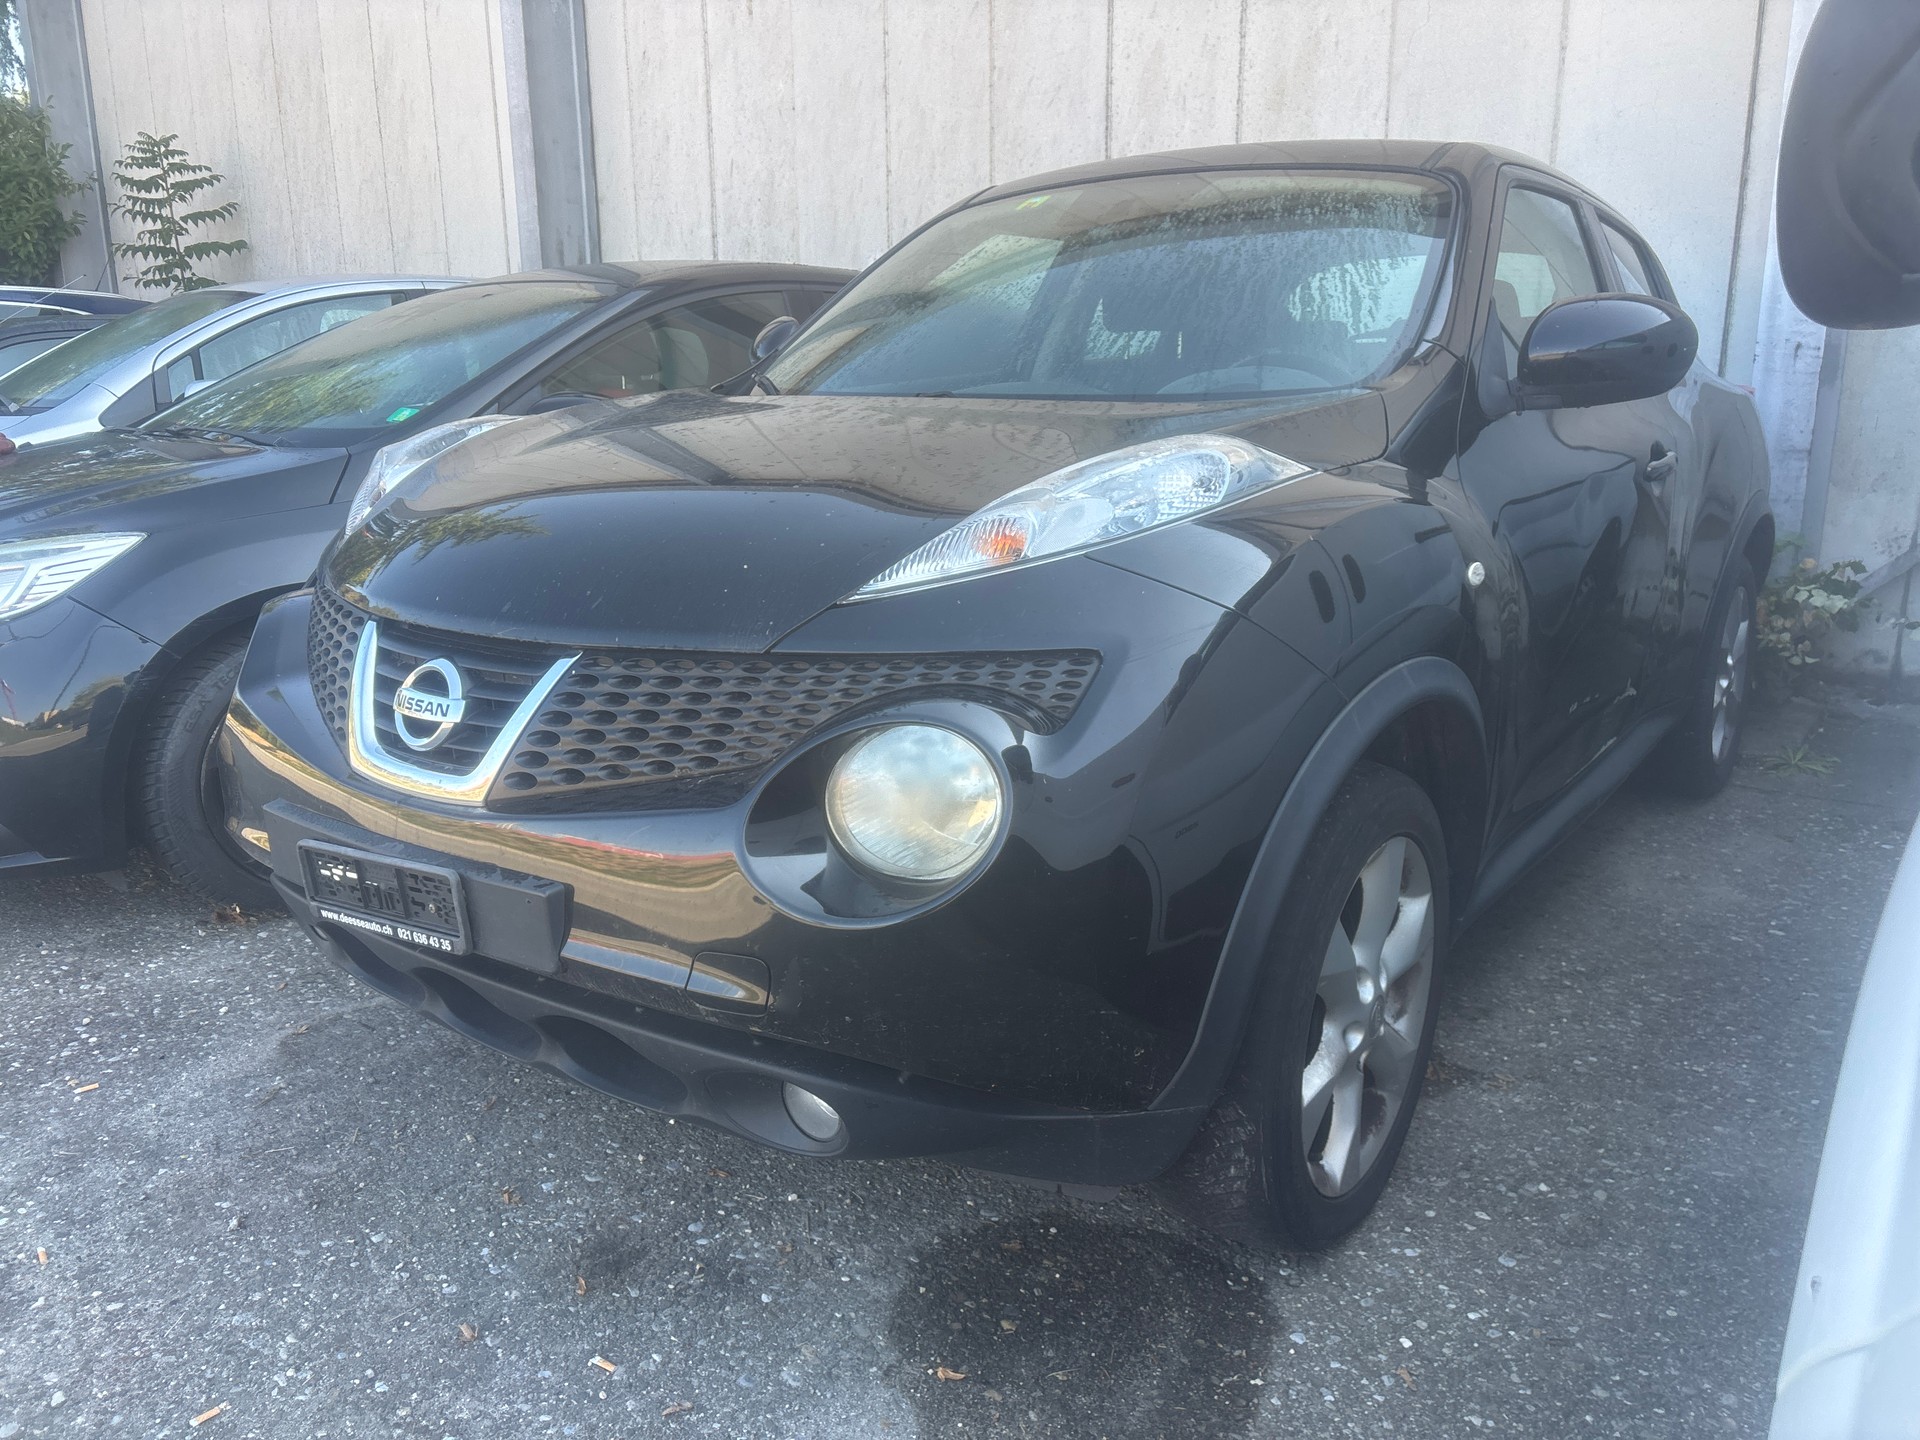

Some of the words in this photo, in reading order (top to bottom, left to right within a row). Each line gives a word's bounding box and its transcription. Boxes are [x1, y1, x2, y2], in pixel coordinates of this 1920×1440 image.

[396, 688, 451, 718] NISSAN
[320, 908, 393, 936] www.deesseauto.ch
[397, 927, 412, 941] 021
[412, 931, 428, 945] 636
[428, 936, 440, 948] 43
[440, 938, 452, 952] 35
